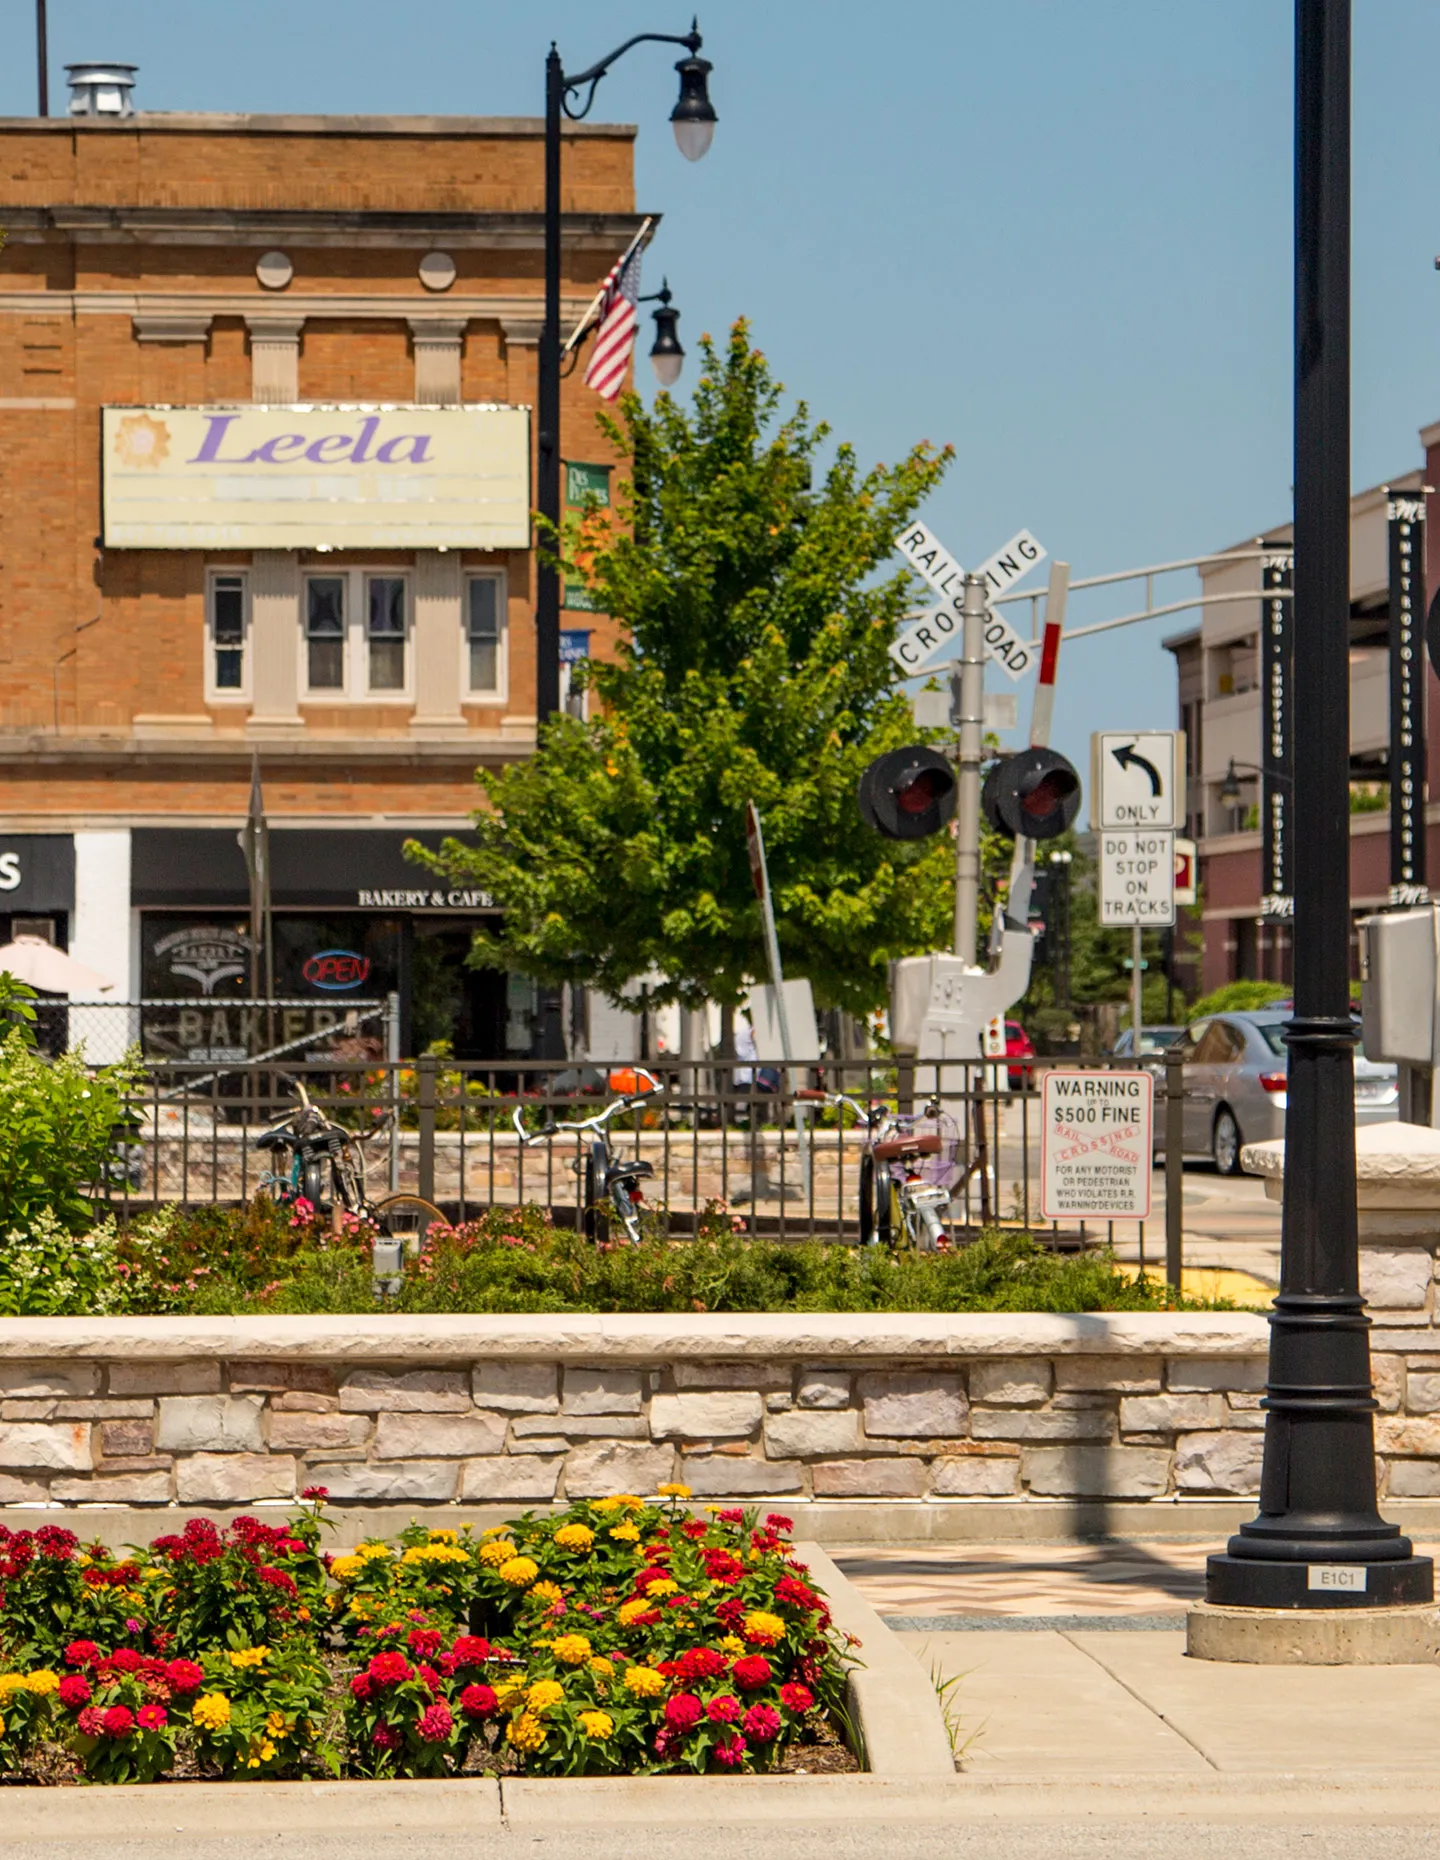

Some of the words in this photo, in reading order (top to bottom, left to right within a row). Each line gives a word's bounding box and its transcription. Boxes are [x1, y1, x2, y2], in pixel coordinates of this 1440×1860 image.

[185, 415, 436, 465] Leela
[904, 531, 957, 596] RAIL
[1116, 806, 1160, 820] ONLY
[1106, 840, 1128, 854] DO
[1136, 840, 1167, 854] NOT
[1116, 861, 1158, 875] STOP
[1126, 882, 1148, 895] ON
[358, 889, 430, 907] BAKERY
[430, 889, 445, 907] &
[1104, 901, 1170, 915] TRACKS
[302, 956, 370, 983] OPEN
[1055, 1080, 1140, 1097] WARNING
[1055, 1107, 1096, 1123] $500
[1101, 1107, 1141, 1123] FINE
[1061, 1127, 1133, 1160] CROSSING
[1055, 1166, 1072, 1175] FOR
[1075, 1166, 1092, 1175] ANY
[1094, 1166, 1137, 1175] MOTORIST
[1063, 1177, 1075, 1186] OR
[1077, 1178, 1130, 1187] PEDESTRIAN
[1056, 1189, 1076, 1198] WHO
[1078, 1189, 1118, 1199] VIOLATES
[1058, 1200, 1097, 1211] WARNING
[1098, 1201, 1135, 1211] DEVICES
[1321, 1571, 1354, 1585] E1C1
